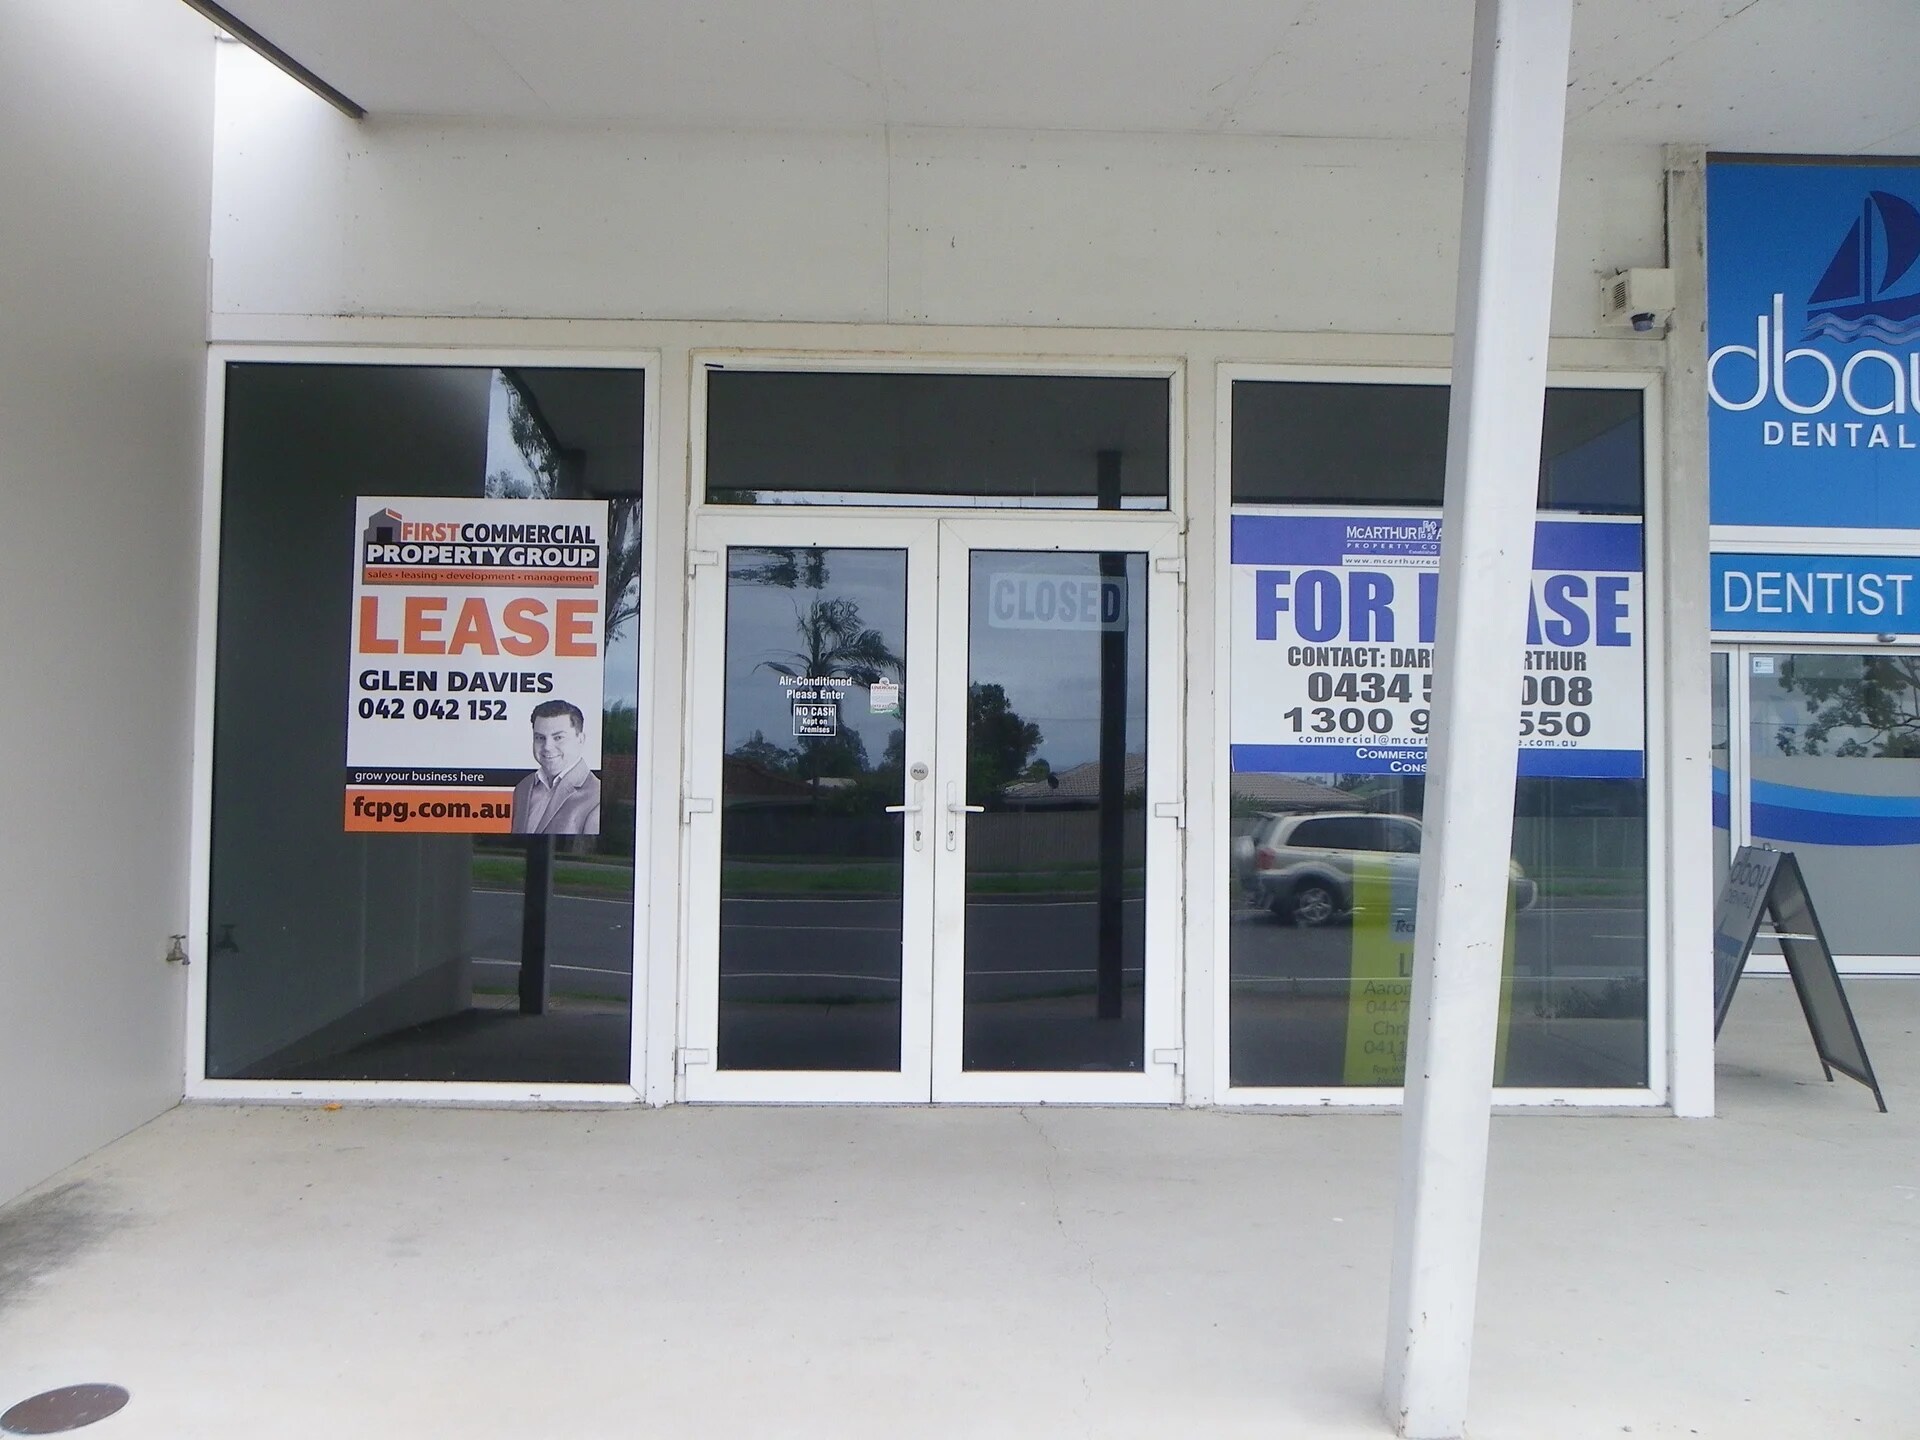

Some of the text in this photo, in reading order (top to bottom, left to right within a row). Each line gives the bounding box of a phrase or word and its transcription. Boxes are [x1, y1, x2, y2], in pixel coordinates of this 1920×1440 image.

[1764, 421, 1916, 449] DENTAL
[1346, 526, 1417, 540] McARTHUR
[367, 545, 596, 567] PROPERTY GROUP
[368, 571, 593, 585] sales leasing development management
[994, 577, 1121, 623] CLOSED
[1723, 571, 1912, 616] DENTIST
[1256, 570, 1395, 643] FOR
[358, 595, 599, 658] LEASE
[1287, 646, 1385, 668] CONTACT:
[359, 670, 554, 694] GLEN DAVIES
[779, 676, 852, 687] Air-Conditioned
[1307, 672, 1412, 703] 0434
[786, 690, 845, 700] Please Enter
[358, 698, 508, 721] 042 042 152
[796, 707, 835, 716] NO CASH
[1283, 706, 1394, 735] 1300
[800, 726, 830, 734] Premises
[355, 770, 485, 784] grow your business here
[353, 796, 511, 823] fcpg.com.au
